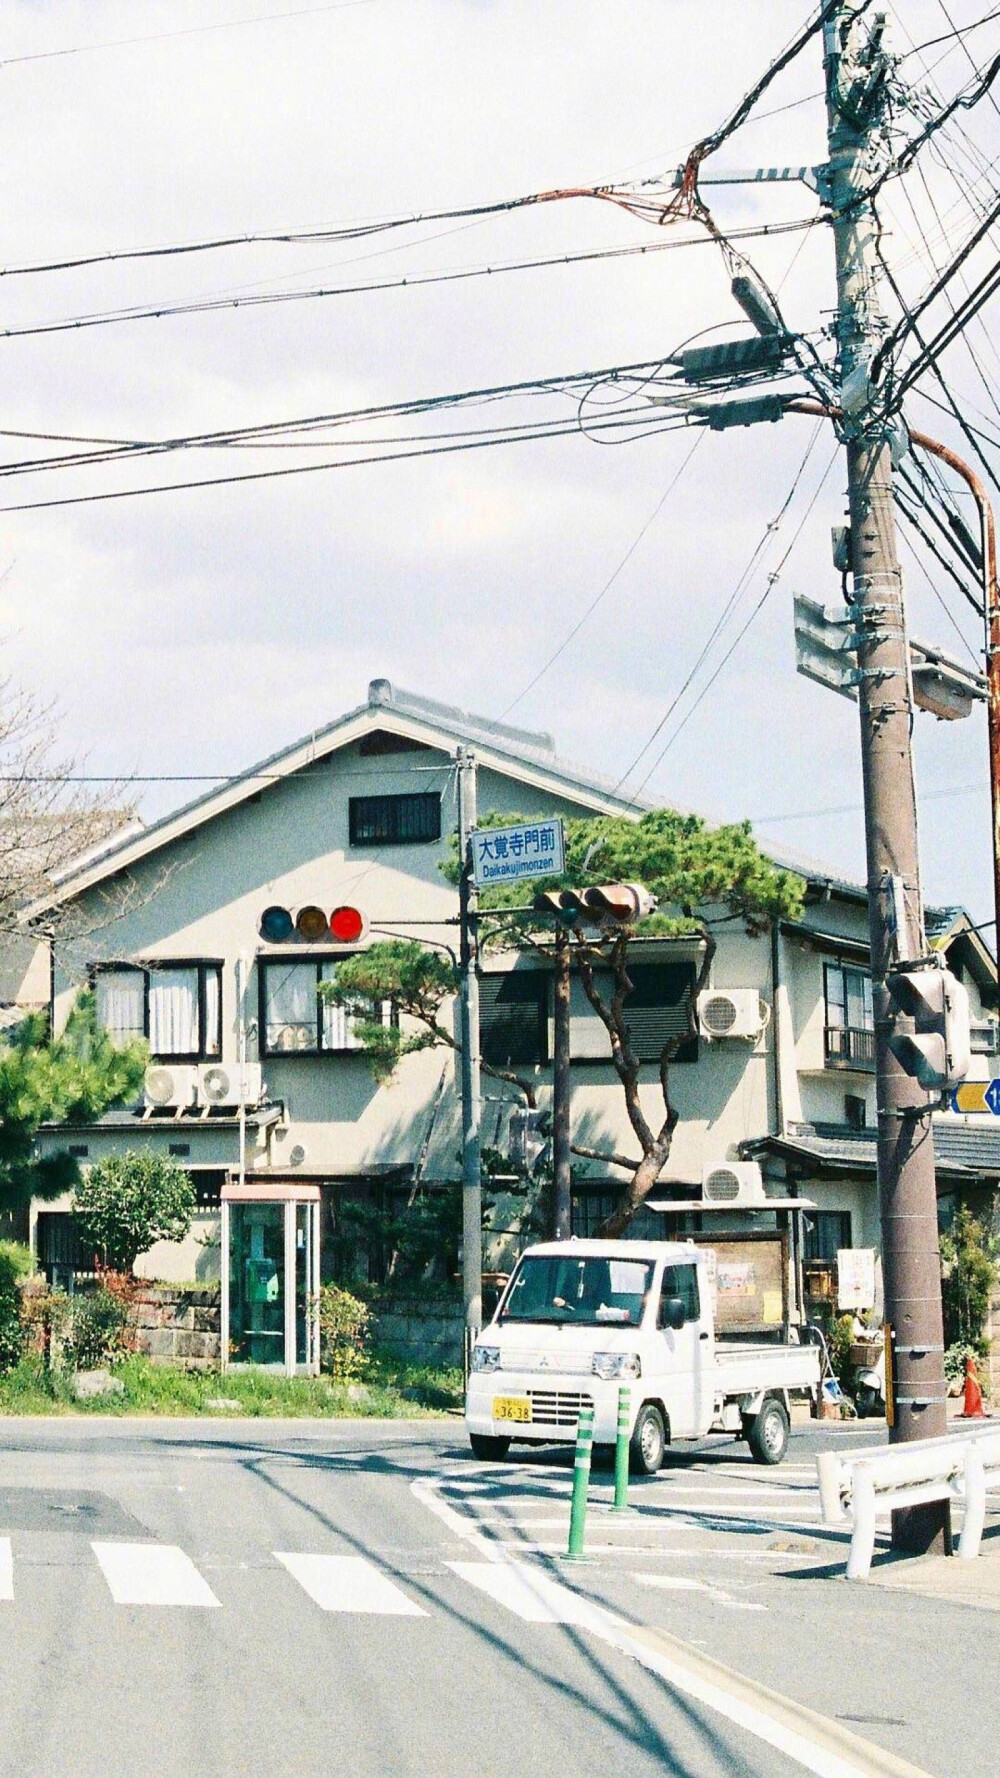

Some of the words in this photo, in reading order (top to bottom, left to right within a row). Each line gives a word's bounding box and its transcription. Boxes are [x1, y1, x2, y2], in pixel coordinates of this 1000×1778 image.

[479, 827, 555, 861] 大覚寺門前
[483, 857, 554, 878] Daikakujimonzen
